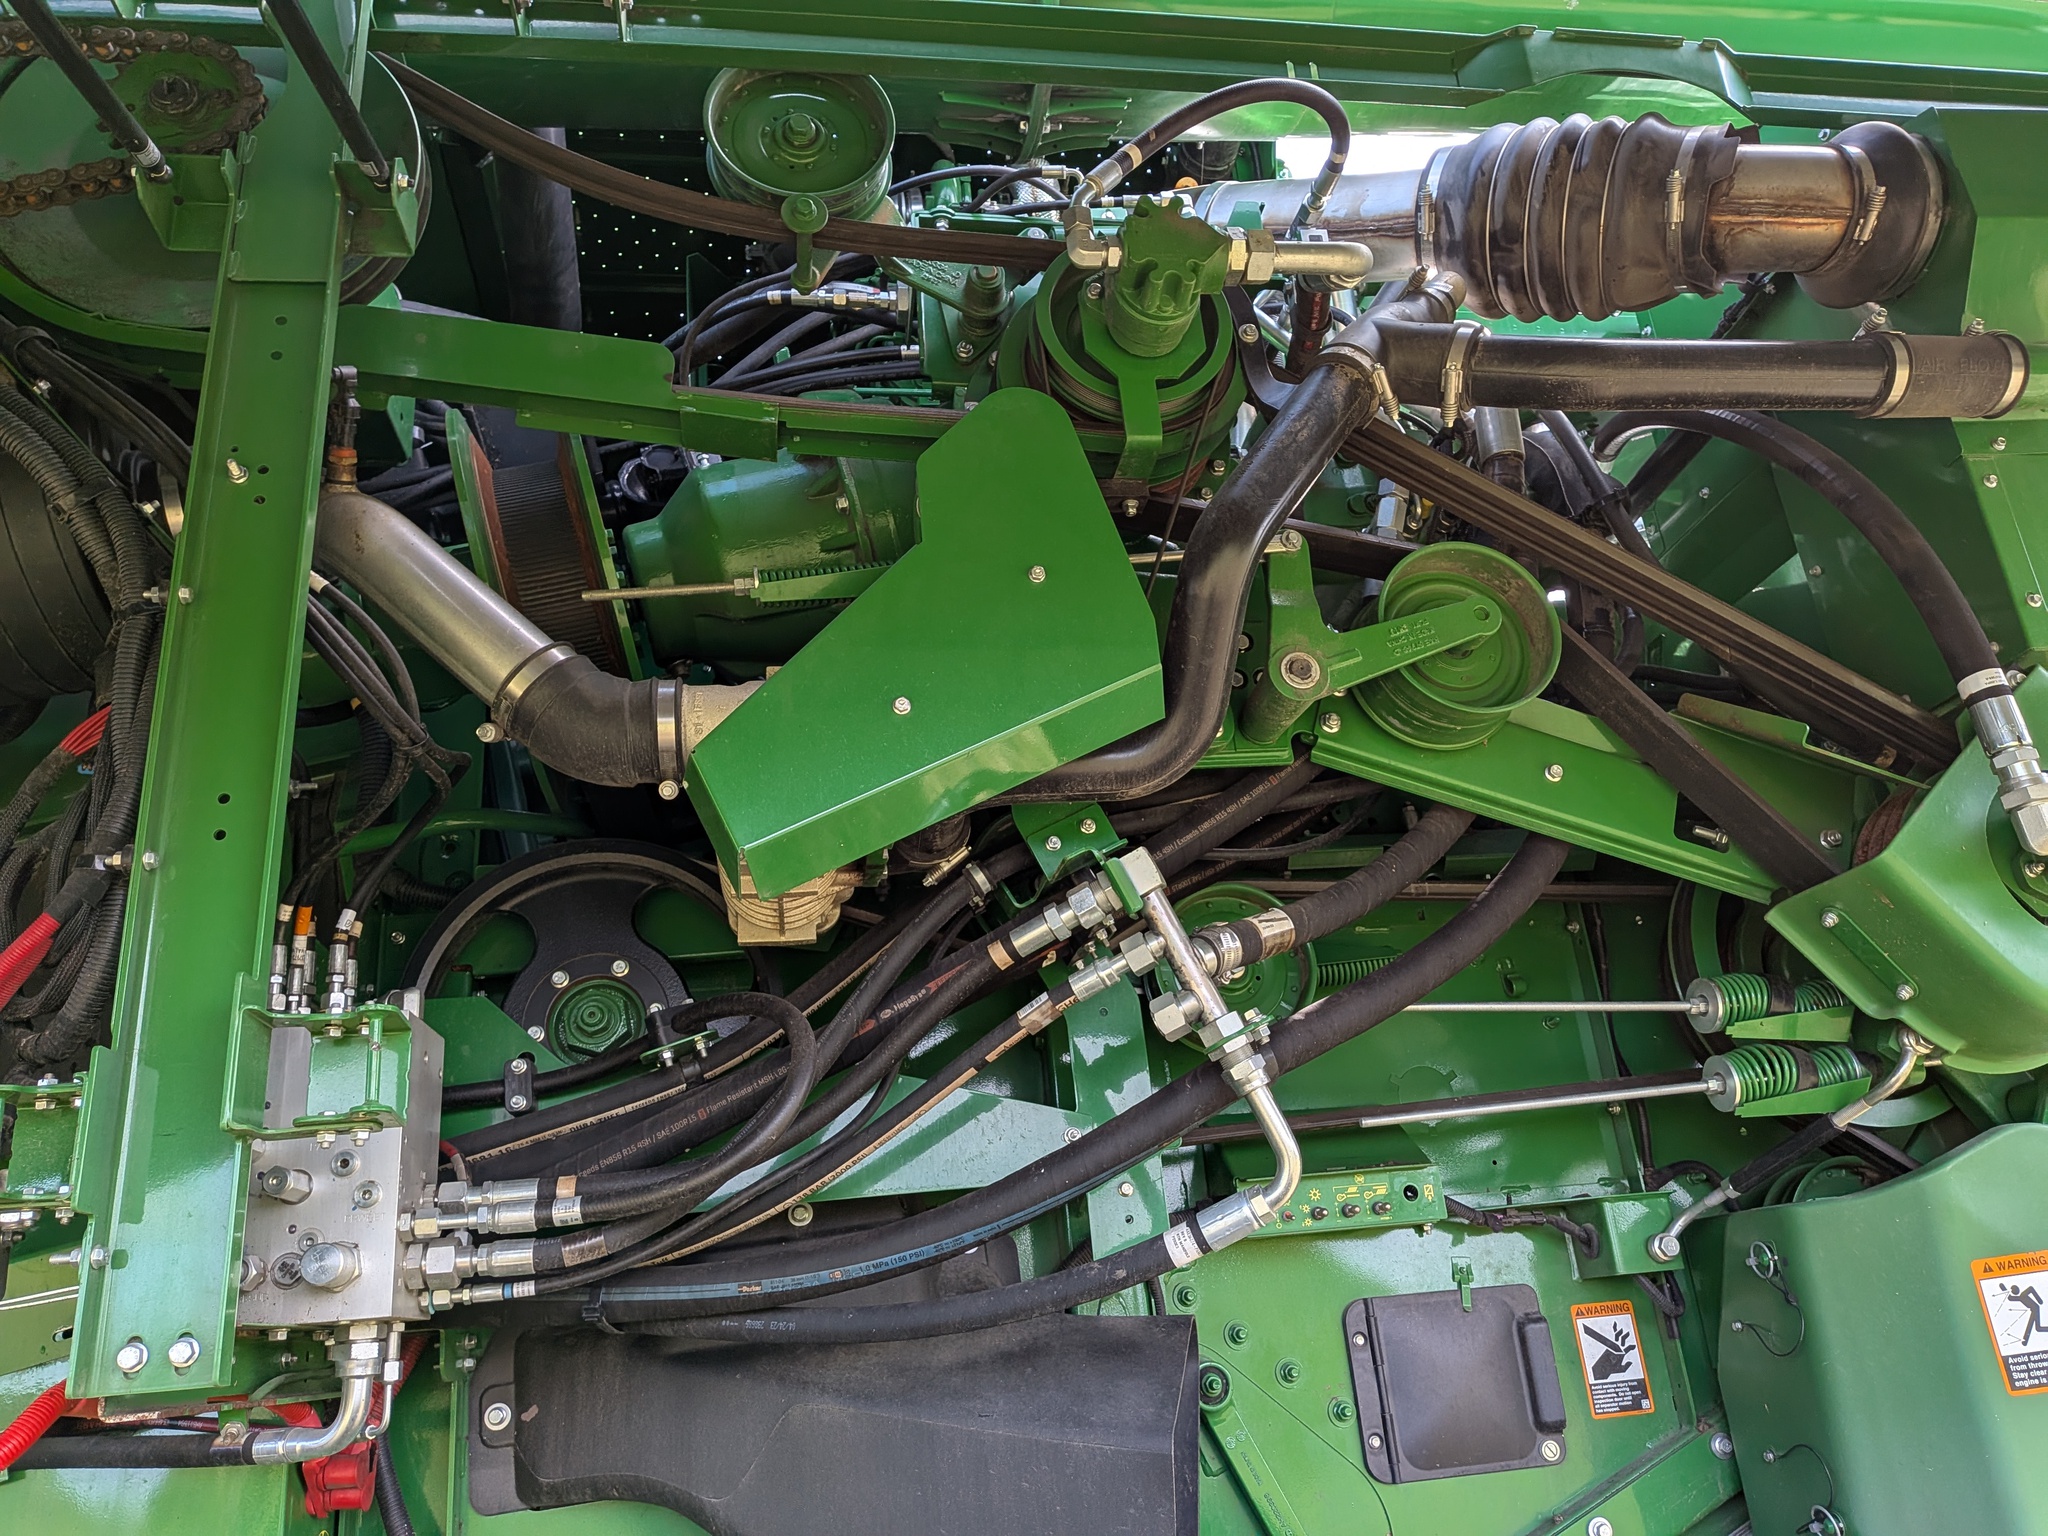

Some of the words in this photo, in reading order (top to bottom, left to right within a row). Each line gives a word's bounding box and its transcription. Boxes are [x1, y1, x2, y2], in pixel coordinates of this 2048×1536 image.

[1920, 358, 1946, 372] AIR
[1177, 828, 1199, 845] Exceeds
[1215, 811, 1227, 821] R15
[1227, 804, 1238, 815] 4SH
[1240, 794, 1251, 804] SAE
[1250, 781, 1271, 798] 100R15
[622, 1145, 638, 1157] R15
[637, 1137, 651, 1151] 4SH
[656, 1127, 671, 1140] SAE
[670, 1114, 697, 1133] 100R15
[706, 1098, 727, 1114] Flame
[727, 1083, 759, 1104] Resistant
[859, 1264, 871, 1273] 1.0
[872, 1260, 890, 1270] MPa
[890, 1254, 908, 1266] (150
[908, 1249, 925, 1261] PSI)
[1996, 1255, 2047, 1271] WARNING
[1585, 1302, 1630, 1316] WARNING
[2008, 1354, 2028, 1364] Avoid
[2010, 1362, 2027, 1372] from
[2028, 1361, 2048, 1369] throw
[2015, 1378, 2039, 1387] engine
